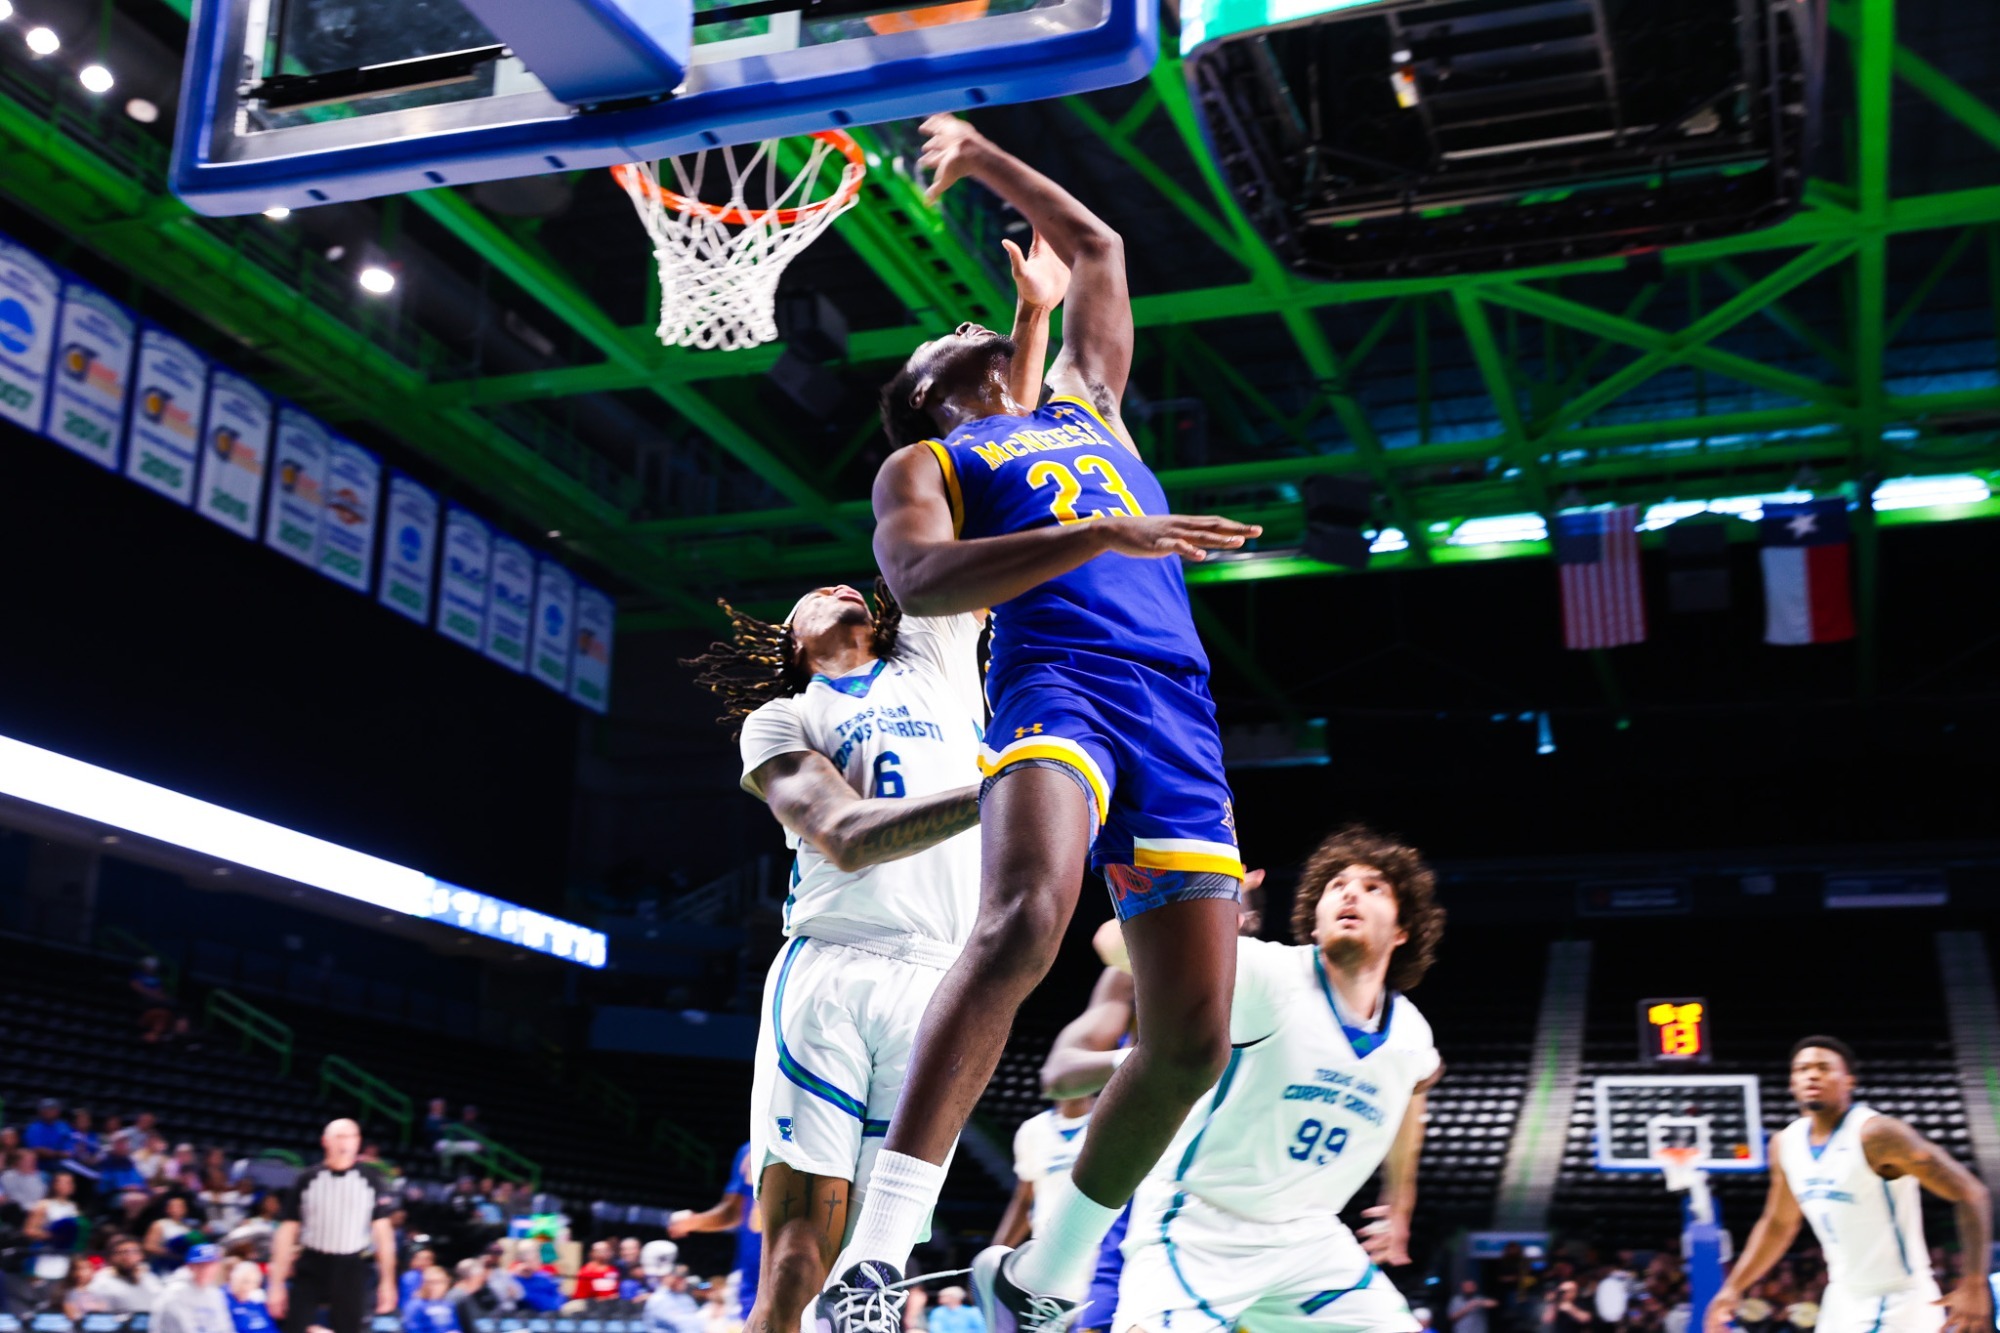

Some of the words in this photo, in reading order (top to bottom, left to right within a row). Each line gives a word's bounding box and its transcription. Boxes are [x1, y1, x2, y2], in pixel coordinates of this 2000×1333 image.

[971, 421, 1112, 471] McNEESE
[1026, 454, 1147, 526] 23
[832, 723, 872, 773] ORUS
[877, 718, 944, 742] CHRISTI
[835, 707, 875, 737] TEAS
[873, 751, 906, 798] 6
[1288, 1118, 1348, 1165] 99
